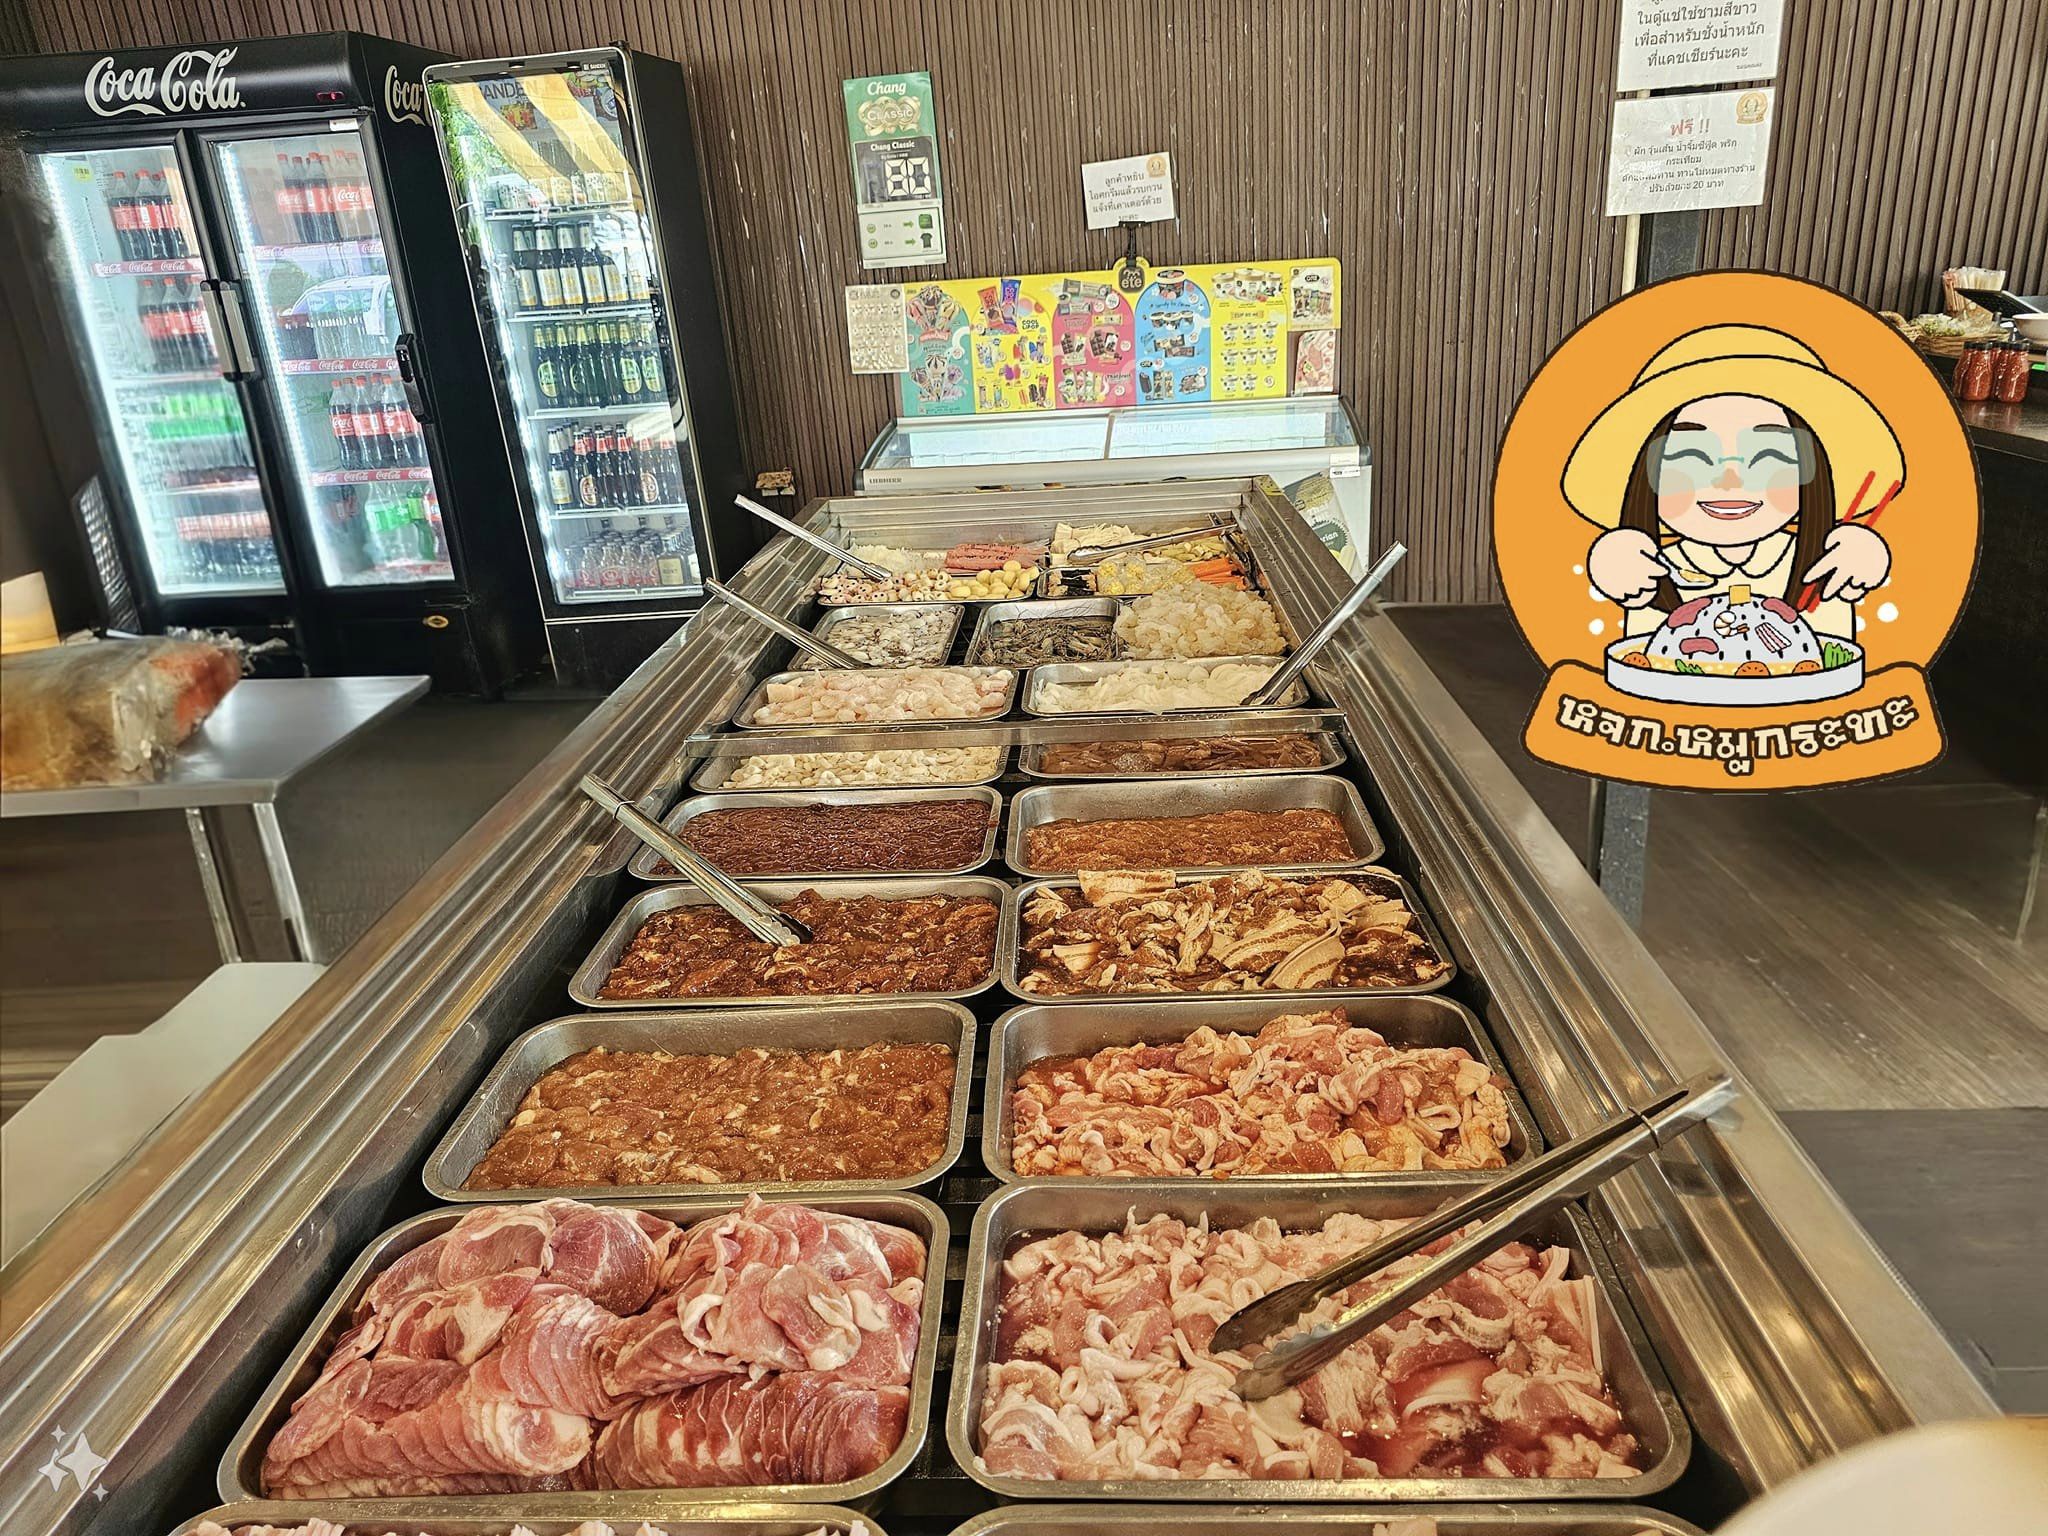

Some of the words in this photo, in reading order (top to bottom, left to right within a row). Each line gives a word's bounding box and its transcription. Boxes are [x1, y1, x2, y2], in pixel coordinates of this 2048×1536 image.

[1634, 21, 1765, 47] เพื่อสำหรับชั่งน้ำหนัก
[867, 81, 907, 96] Chang
[867, 108, 914, 121] CLASSIC
[1670, 118, 1694, 136] ฟรี
[870, 143, 891, 152] Chang
[891, 141, 915, 150] Classic
[1666, 154, 1702, 166] กระเทียม
[1105, 172, 1145, 188] ลูกค้าหยิบ
[1693, 180, 1704, 190] 20
